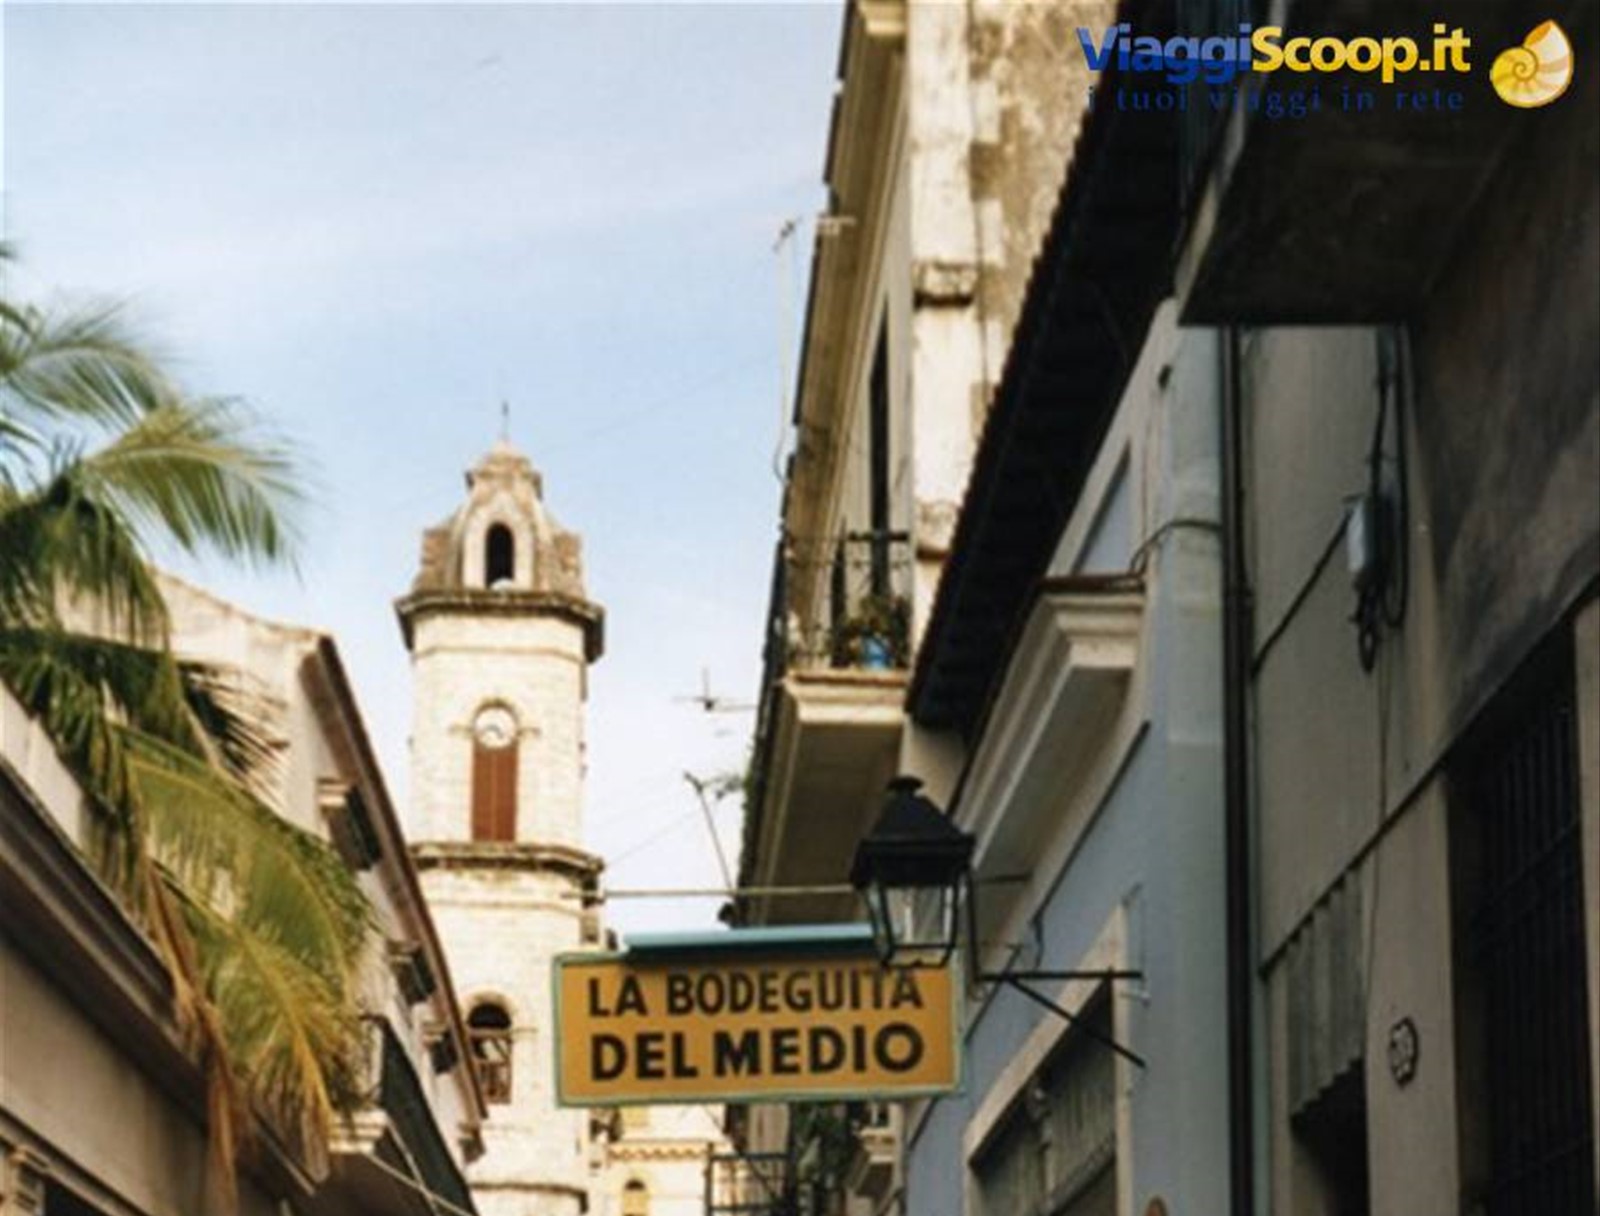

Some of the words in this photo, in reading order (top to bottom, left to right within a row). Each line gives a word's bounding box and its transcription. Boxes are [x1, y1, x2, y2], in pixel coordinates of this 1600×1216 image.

[589, 976, 648, 1016] LA
[667, 967, 924, 1016] BODEGUITA
[591, 1032, 698, 1081] DEL
[713, 1023, 924, 1077] MEDIO
